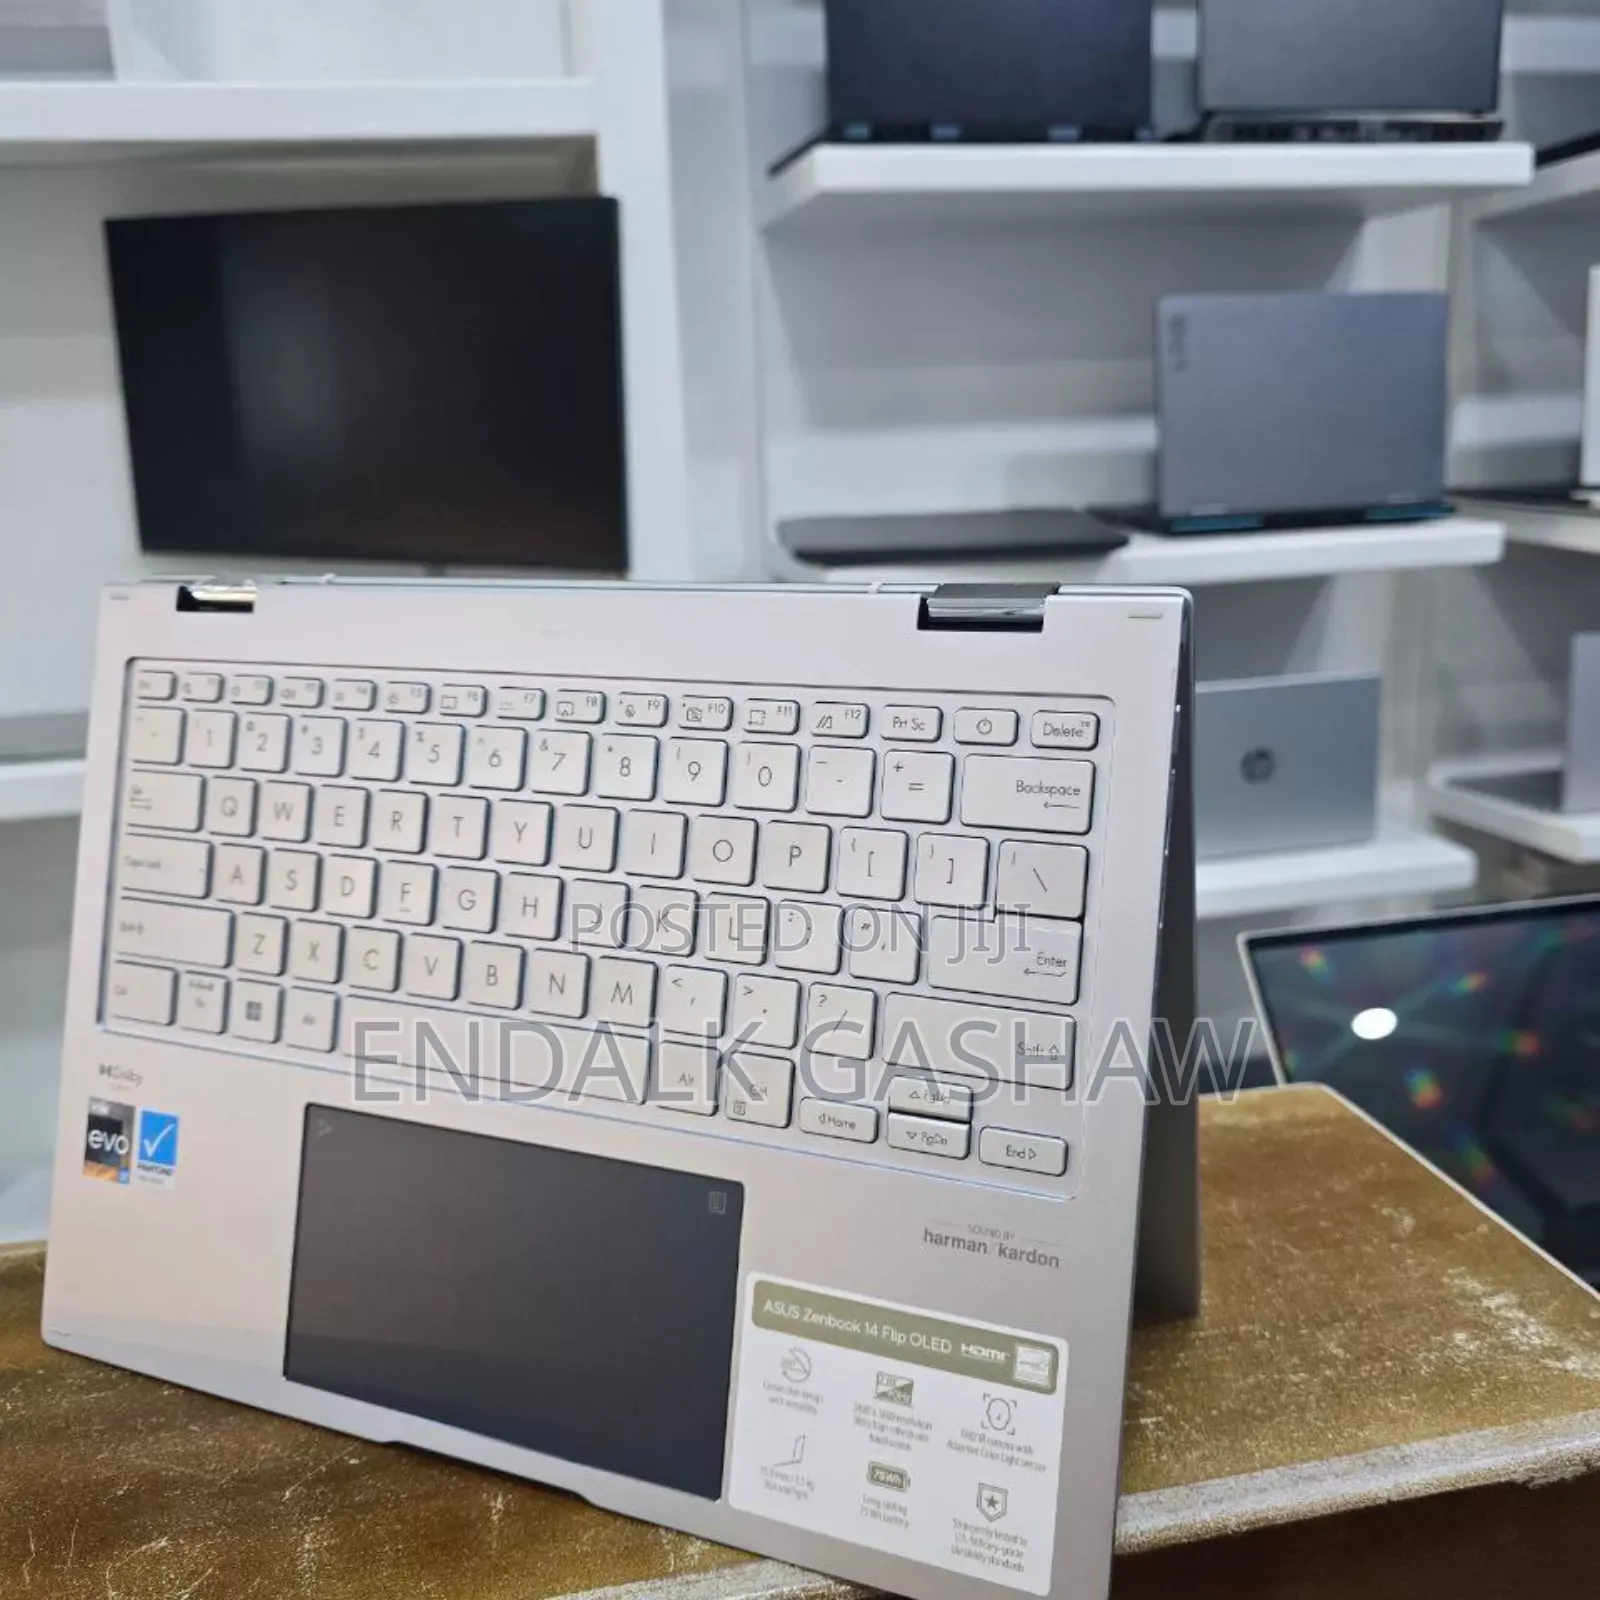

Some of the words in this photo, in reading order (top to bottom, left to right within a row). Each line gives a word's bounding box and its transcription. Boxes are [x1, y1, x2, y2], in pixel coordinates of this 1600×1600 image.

[586, 696, 598, 708] F8
[648, 700, 660, 711] F9
[708, 703, 726, 714] F10
[777, 706, 792, 716] F11
[845, 709, 861, 720] F12
[911, 718, 926, 731] Sc
[1043, 723, 1084, 739] Delete
[256, 732, 268, 752] 2
[311, 736, 324, 756] 3
[368, 741, 381, 759] 4
[428, 744, 441, 765] 5
[488, 750, 501, 768] 6
[551, 753, 566, 772] 7
[619, 756, 631, 777] 8
[687, 761, 701, 781] 9
[893, 762, 904, 773] +
[908, 782, 925, 791] =
[1016, 780, 1081, 798] Backspace
[221, 796, 239, 817] Q
[273, 802, 294, 822] W
[333, 806, 345, 828] E
[390, 810, 402, 833] R
[452, 816, 464, 838] T
[513, 821, 529, 844] Y
[578, 827, 594, 849] U
[789, 845, 802, 867] P
[867, 851, 875, 878] [
[230, 865, 244, 885] A
[286, 870, 298, 892] S
[946, 858, 954, 884] ]
[1033, 868, 1048, 892] \
[340, 876, 356, 897] D
[400, 882, 411, 903] F
[457, 889, 477, 911] G
[522, 896, 538, 918] H
[655, 909, 670, 934] K
[729, 917, 741, 941] L
[253, 933, 267, 956] Z
[308, 940, 320, 962] X
[362, 949, 380, 971] C
[423, 956, 440, 977] V
[1036, 952, 1068, 969] Enter
[486, 965, 499, 987] B
[549, 973, 566, 996] N
[671, 976, 683, 988] <
[611, 981, 633, 1006] M
[742, 985, 755, 997] >
[818, 994, 828, 1008] ?
[828, 1114, 857, 1131] Home
[87, 1128, 129, 1155] evo
[921, 1131, 948, 1147] PgDn
[1005, 1144, 1026, 1159] End
[923, 1226, 988, 1255] harman
[997, 1242, 1061, 1269] kardon
[763, 1299, 801, 1320] ASUS
[803, 1309, 862, 1334] Zenbook
[865, 1321, 880, 1337] 14
[881, 1325, 907, 1346] Flip
[909, 1332, 953, 1354] OLED
